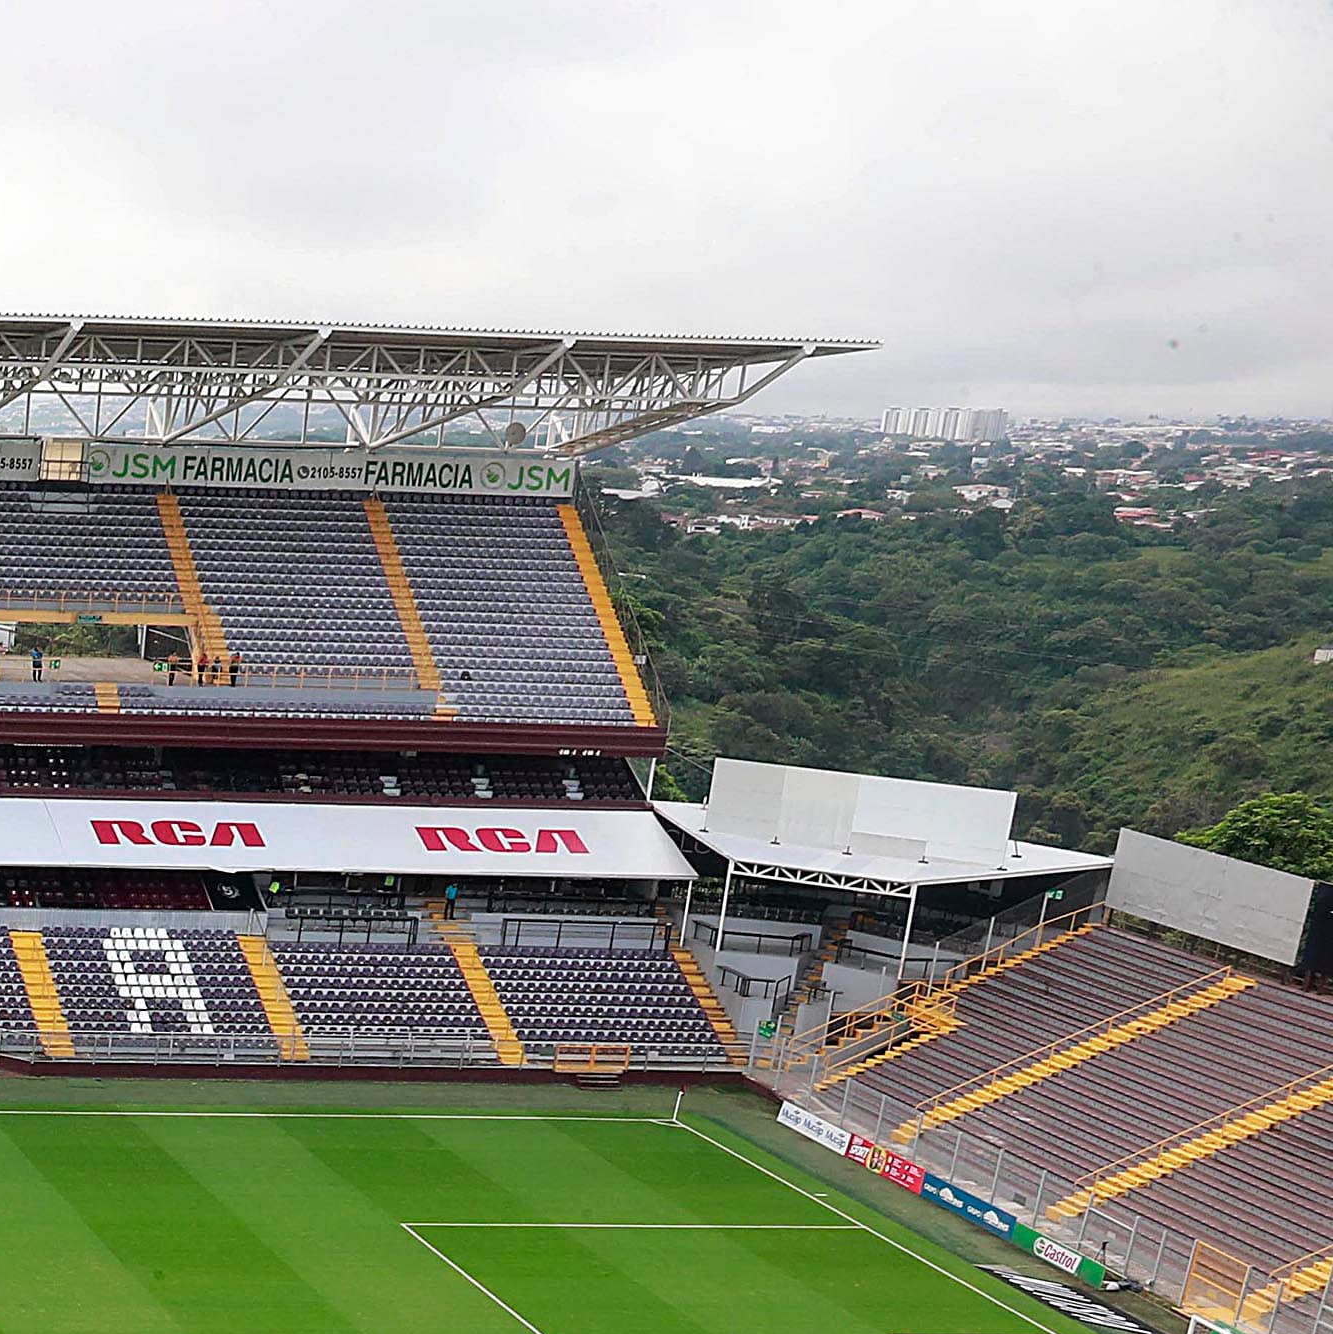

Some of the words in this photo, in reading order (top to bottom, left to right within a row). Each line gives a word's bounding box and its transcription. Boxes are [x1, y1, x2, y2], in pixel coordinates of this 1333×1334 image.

[112, 453, 176, 479] JSM
[183, 456, 294, 483] FARMACIA
[310, 466, 363, 479] 2105-8557
[364, 461, 473, 489] FARMACIA
[507, 465, 570, 491] JSM
[91, 819, 266, 847] RCA
[416, 826, 589, 855] RCA
[804, 1118, 823, 1136] Mucap
[826, 1130, 845, 1149] Mucap
[1044, 1244, 1077, 1270] Castrol
